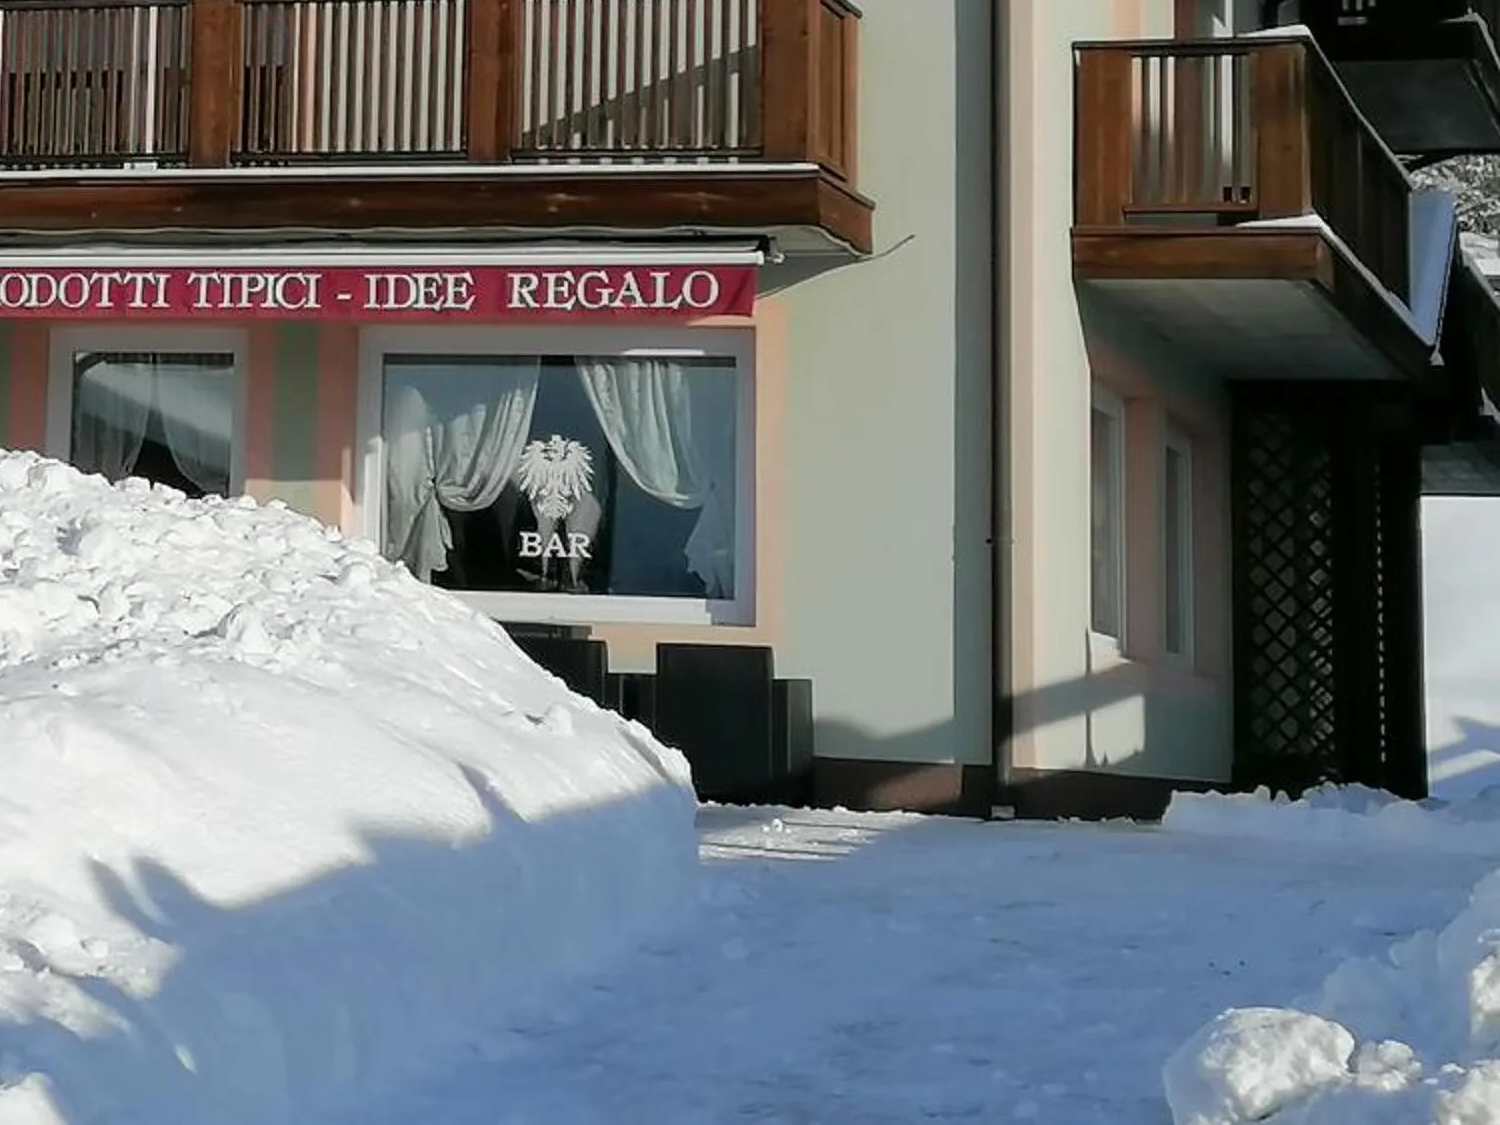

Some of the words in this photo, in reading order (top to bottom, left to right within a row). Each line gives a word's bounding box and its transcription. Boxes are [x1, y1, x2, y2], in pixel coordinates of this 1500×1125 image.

[187, 273, 321, 309] TIPICI
[363, 273, 477, 311] IDEE
[506, 271, 721, 309] REGALO
[519, 531, 592, 558] BAR
